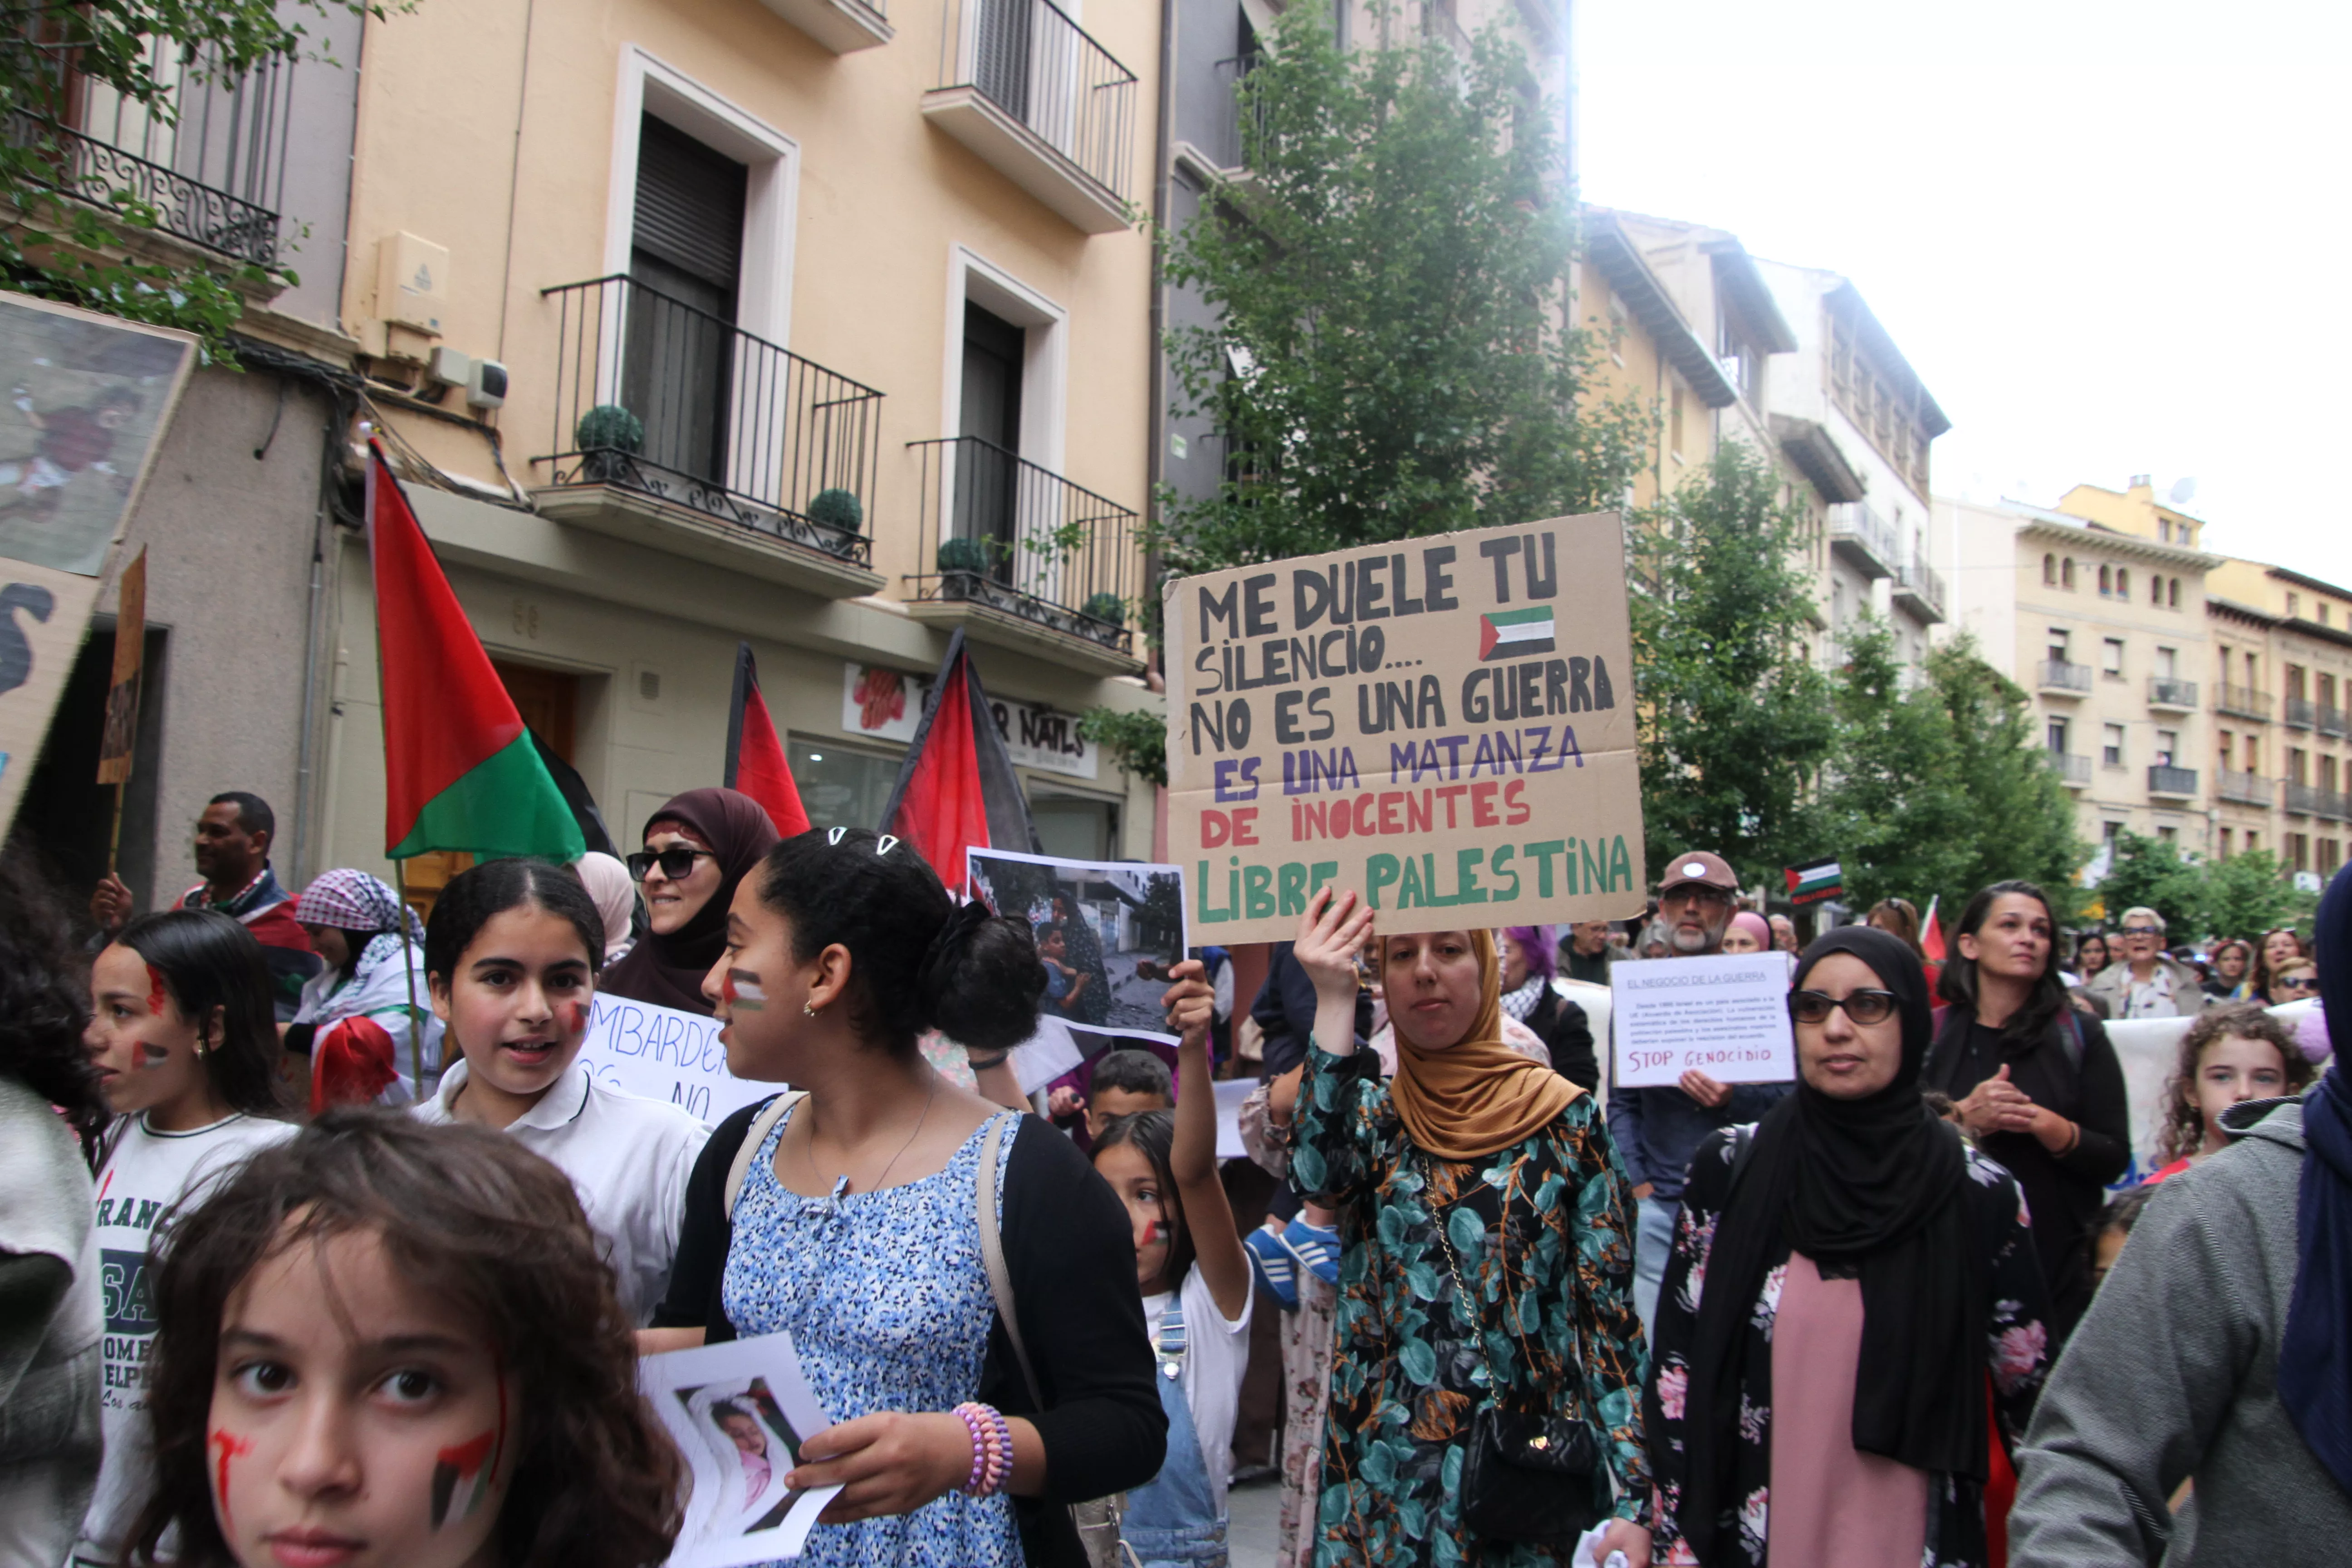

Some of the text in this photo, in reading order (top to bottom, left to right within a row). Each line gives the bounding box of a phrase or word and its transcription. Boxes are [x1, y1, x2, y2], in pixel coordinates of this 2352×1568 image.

[1198, 533, 1558, 643] ME DUELE TU
[1191, 655, 1615, 755] NO ES UNA GUERRA
[1019, 709, 1084, 758] NAILS
[1214, 725, 1584, 803] ES UNA MATANZA
[1200, 807, 1259, 849] DE
[1627, 972, 1767, 989] EL NEGOCIO DE LA GUERRA
[1629, 1050, 1673, 1072] STOP
